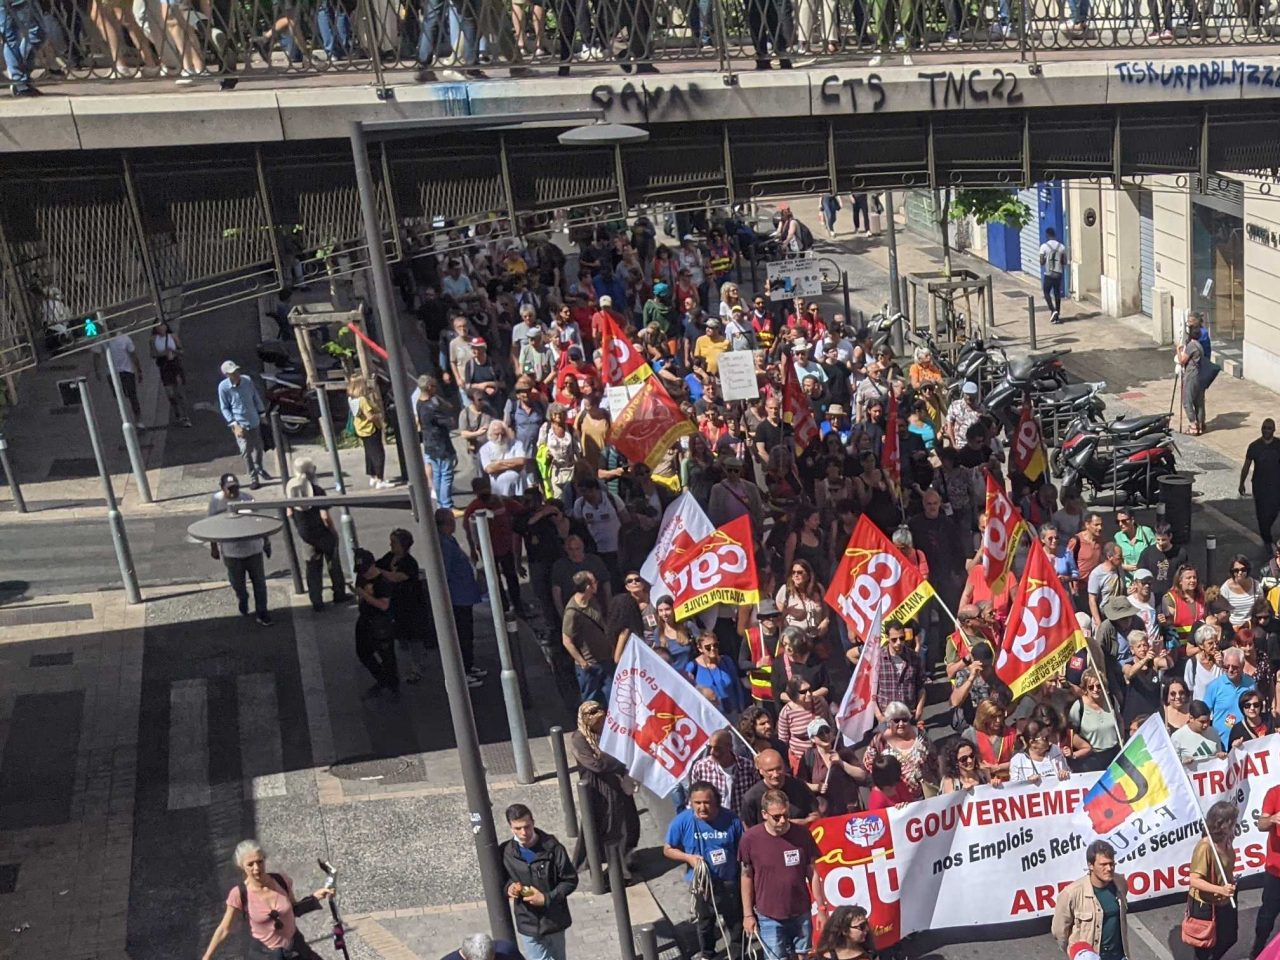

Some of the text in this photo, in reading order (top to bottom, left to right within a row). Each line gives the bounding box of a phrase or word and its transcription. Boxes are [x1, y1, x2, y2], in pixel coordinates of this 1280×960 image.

[851, 823, 881, 836] FSM
[933, 826, 1034, 876] nos Emplois
[1021, 848, 1047, 873] nos
